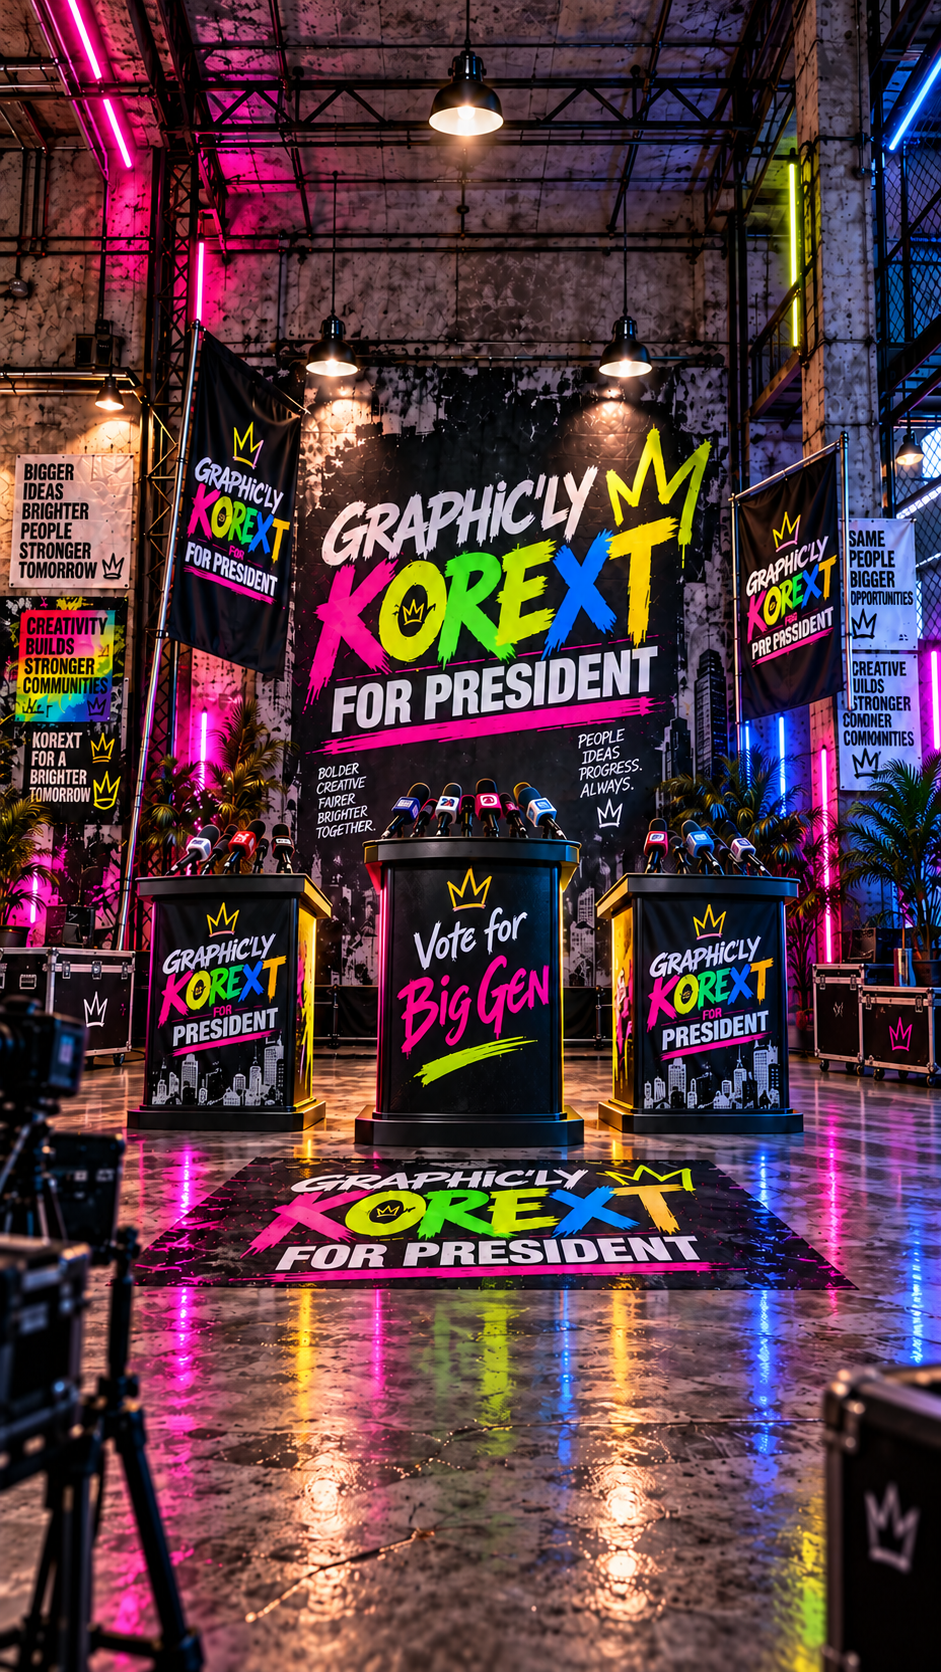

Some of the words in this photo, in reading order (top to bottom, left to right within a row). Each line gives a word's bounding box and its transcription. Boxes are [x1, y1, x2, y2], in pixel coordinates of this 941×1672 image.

[24, 463, 74, 481] BIGGER
[23, 483, 64, 500] IDEAS
[22, 503, 89, 520] BRIGHTER
[21, 522, 72, 540] PEOPLE
[186, 483, 290, 564] KOREXT
[849, 530, 885, 547] SAME
[19, 542, 91, 559] STRONGER
[228, 545, 245, 561] FOR
[849, 550, 896, 568] PEOPLE
[19, 562, 98, 579] TOMORROW
[185, 541, 212, 570] FOR
[212, 552, 278, 597] PRESIDENT
[850, 571, 895, 588] BIGGER
[746, 554, 838, 644] KOREXT
[304, 516, 679, 710] KOREXT
[26, 616, 108, 636] CREATIVITY
[25, 638, 75, 656] BUILDS
[24, 657, 95, 675] STRONGER
[852, 661, 907, 677] CREATIVE
[23, 677, 108, 695] COMMUNITIES
[331, 679, 412, 733] FOR
[424, 645, 658, 721] PRESIDENT
[32, 731, 83, 749] KOREXT
[578, 728, 625, 749] PEOPLE
[31, 750, 55, 767] FOR
[57, 750, 67, 767] A
[581, 745, 620, 765] IDEAS
[29, 769, 87, 785] BRIGHTER
[318, 762, 359, 780] BOLDER
[578, 758, 643, 781] PROGRESS.
[316, 776, 367, 795] CREATIVE
[580, 777, 635, 798] ALWAYS.
[29, 787, 91, 803] TOMORROW
[318, 793, 356, 810] FAIRER
[317, 805, 368, 825] BRIGHTER
[315, 820, 376, 839] TOGETHER.
[413, 920, 477, 970] Vote
[484, 906, 528, 955] for
[157, 955, 287, 1029] KOREXT
[647, 957, 774, 1033] KOREXT
[213, 1005, 232, 1018] FOR
[702, 1007, 723, 1021] FOR
[172, 1007, 279, 1047] PRESIDENT
[662, 1010, 769, 1051] PRESIDENT
[239, 1184, 685, 1259] KOREXT
[275, 1243, 388, 1271] FOR
[403, 1235, 701, 1266] PRESIDENT
